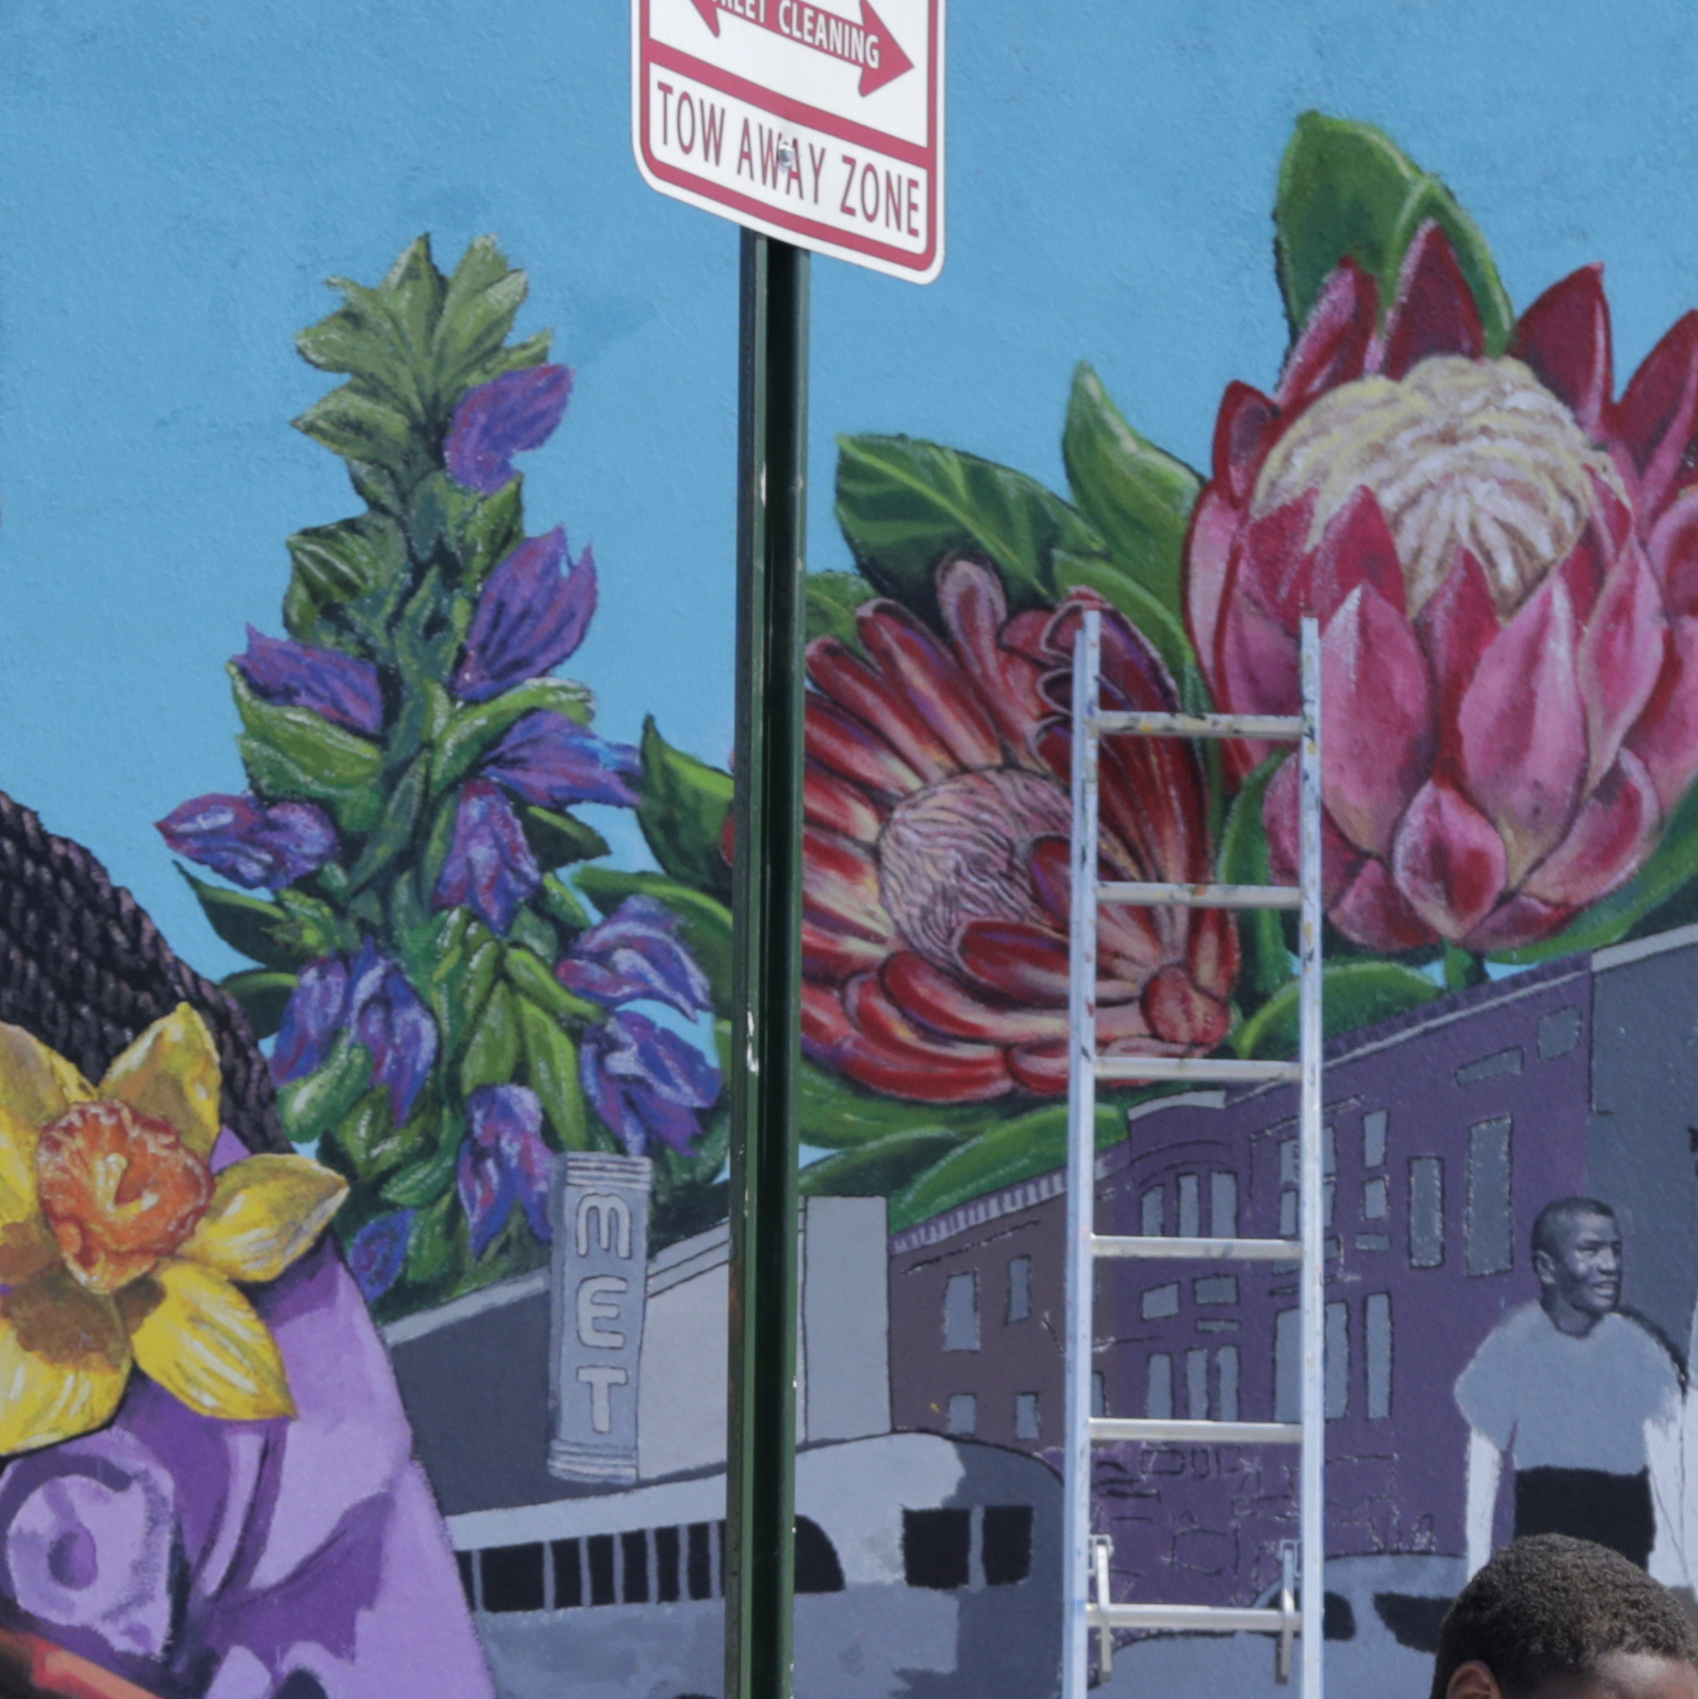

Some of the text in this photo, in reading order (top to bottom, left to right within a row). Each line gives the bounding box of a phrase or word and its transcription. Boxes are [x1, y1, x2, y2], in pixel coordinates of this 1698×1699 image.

[778, 0, 881, 69] CLEANING
[656, 81, 920, 237] TOW AWAY ZONE
